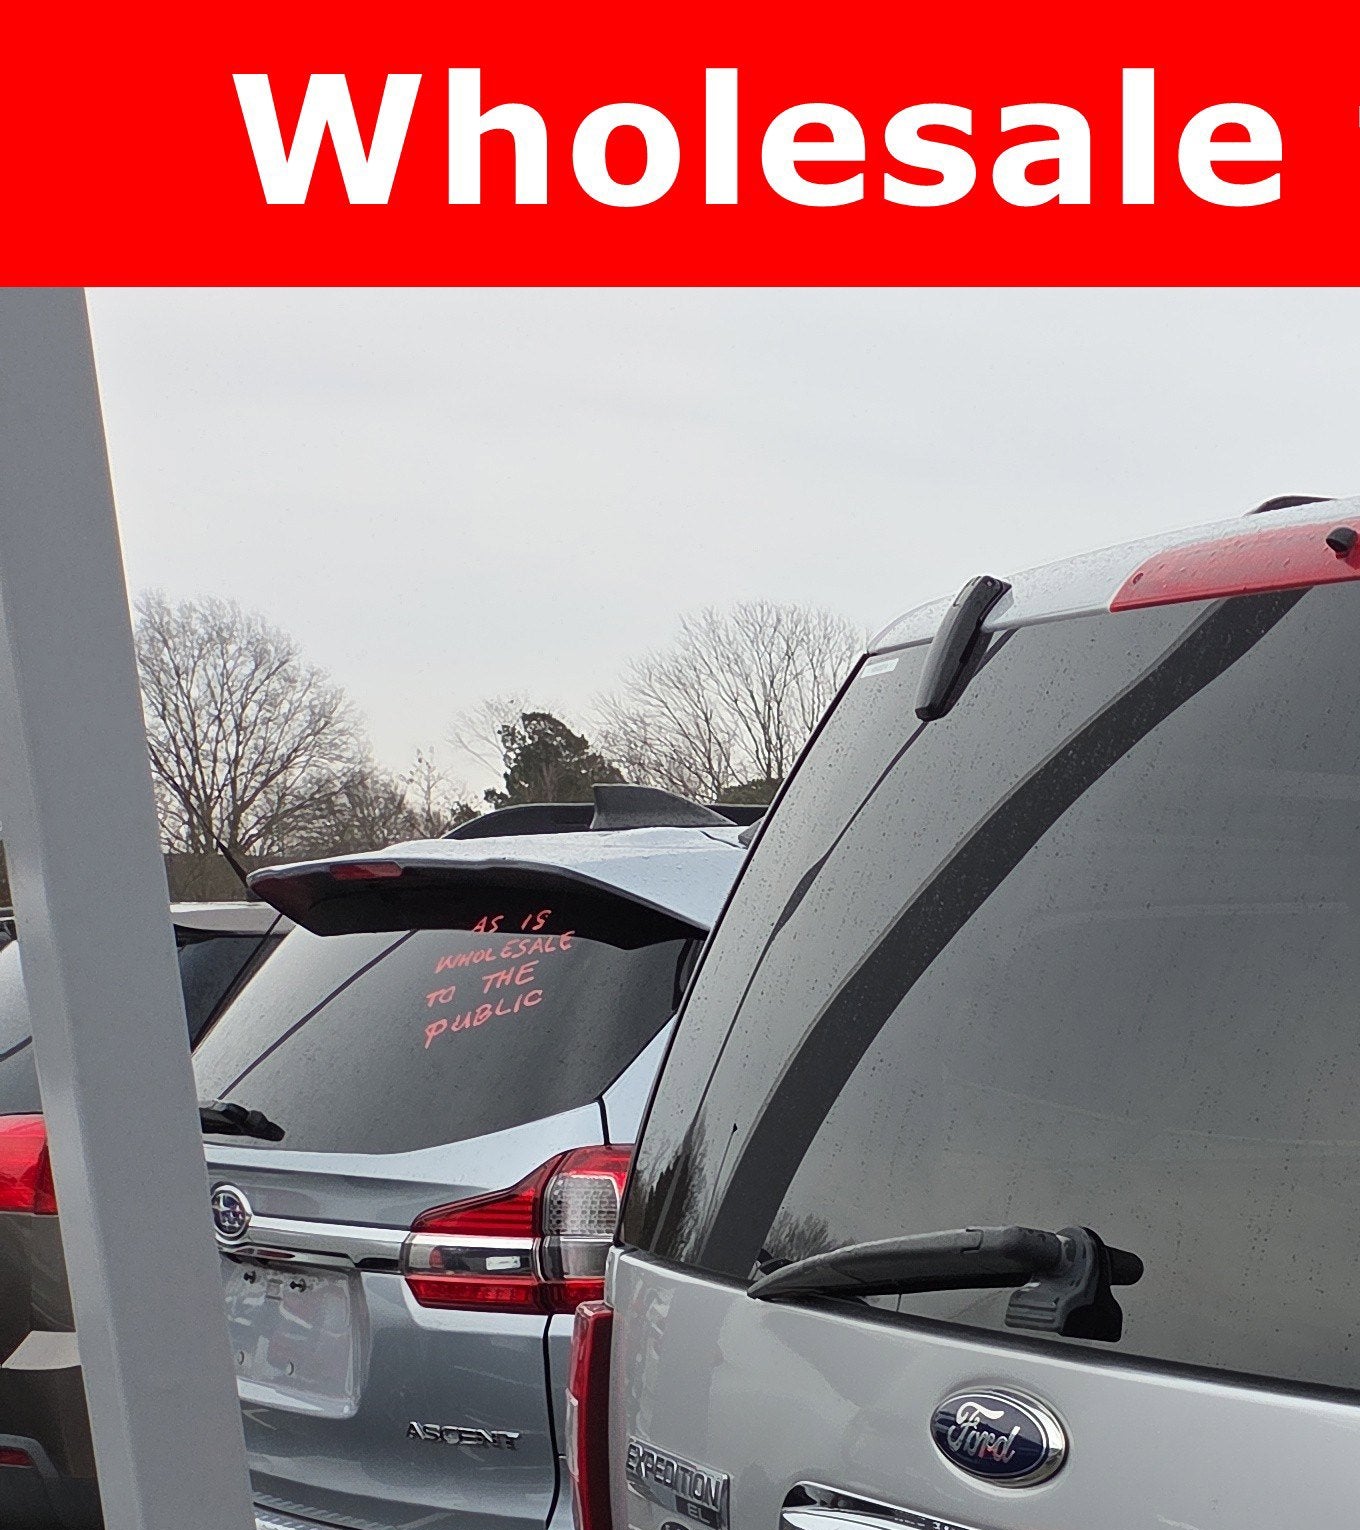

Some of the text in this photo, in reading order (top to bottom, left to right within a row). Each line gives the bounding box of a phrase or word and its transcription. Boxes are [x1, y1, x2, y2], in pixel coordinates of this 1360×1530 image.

[472, 909, 552, 935] AS IS
[434, 930, 575, 974] WHOLESALE
[426, 960, 540, 1008] TO THE
[424, 989, 543, 1050] PUBLIC
[406, 1421, 520, 1450] ASCENT
[947, 1401, 1021, 1463] Ford
[626, 1442, 722, 1511] EXPEDITION
[687, 1503, 711, 1524] EL
